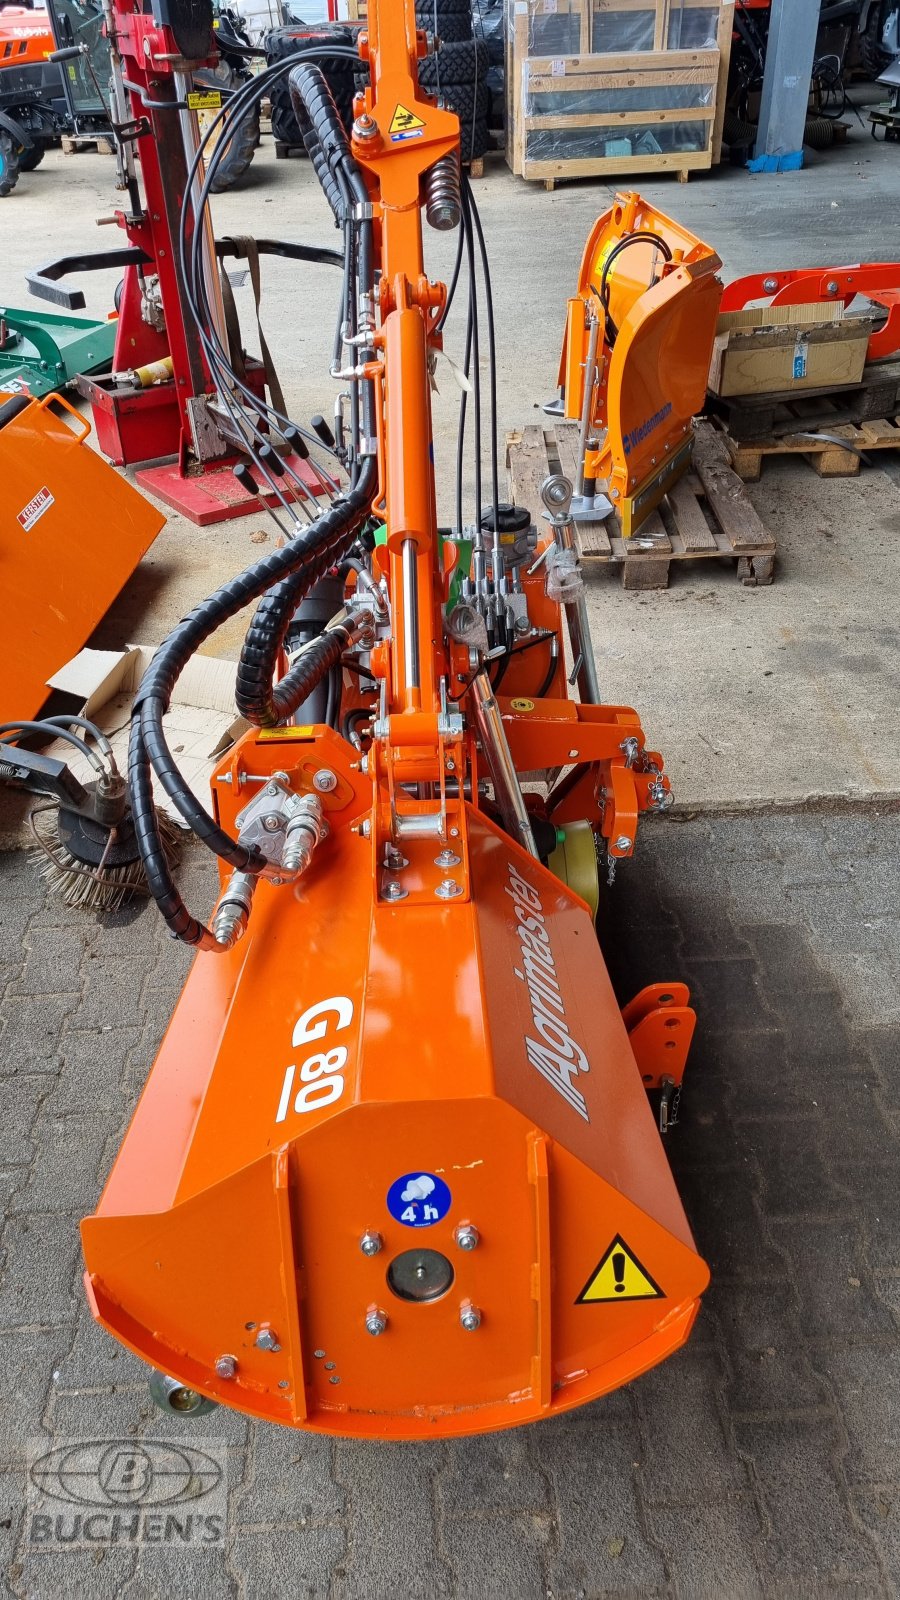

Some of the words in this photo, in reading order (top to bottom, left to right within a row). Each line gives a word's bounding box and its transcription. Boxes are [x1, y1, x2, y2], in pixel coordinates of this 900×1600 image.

[630, 402, 672, 448] Wiedenmann
[22, 492, 47, 521] KERSTEN
[504, 863, 590, 1123] Agrimaster
[291, 996, 354, 1048] G
[294, 1046, 348, 1113] 80
[401, 1206, 417, 1222] 4
[423, 1204, 439, 1220] h
